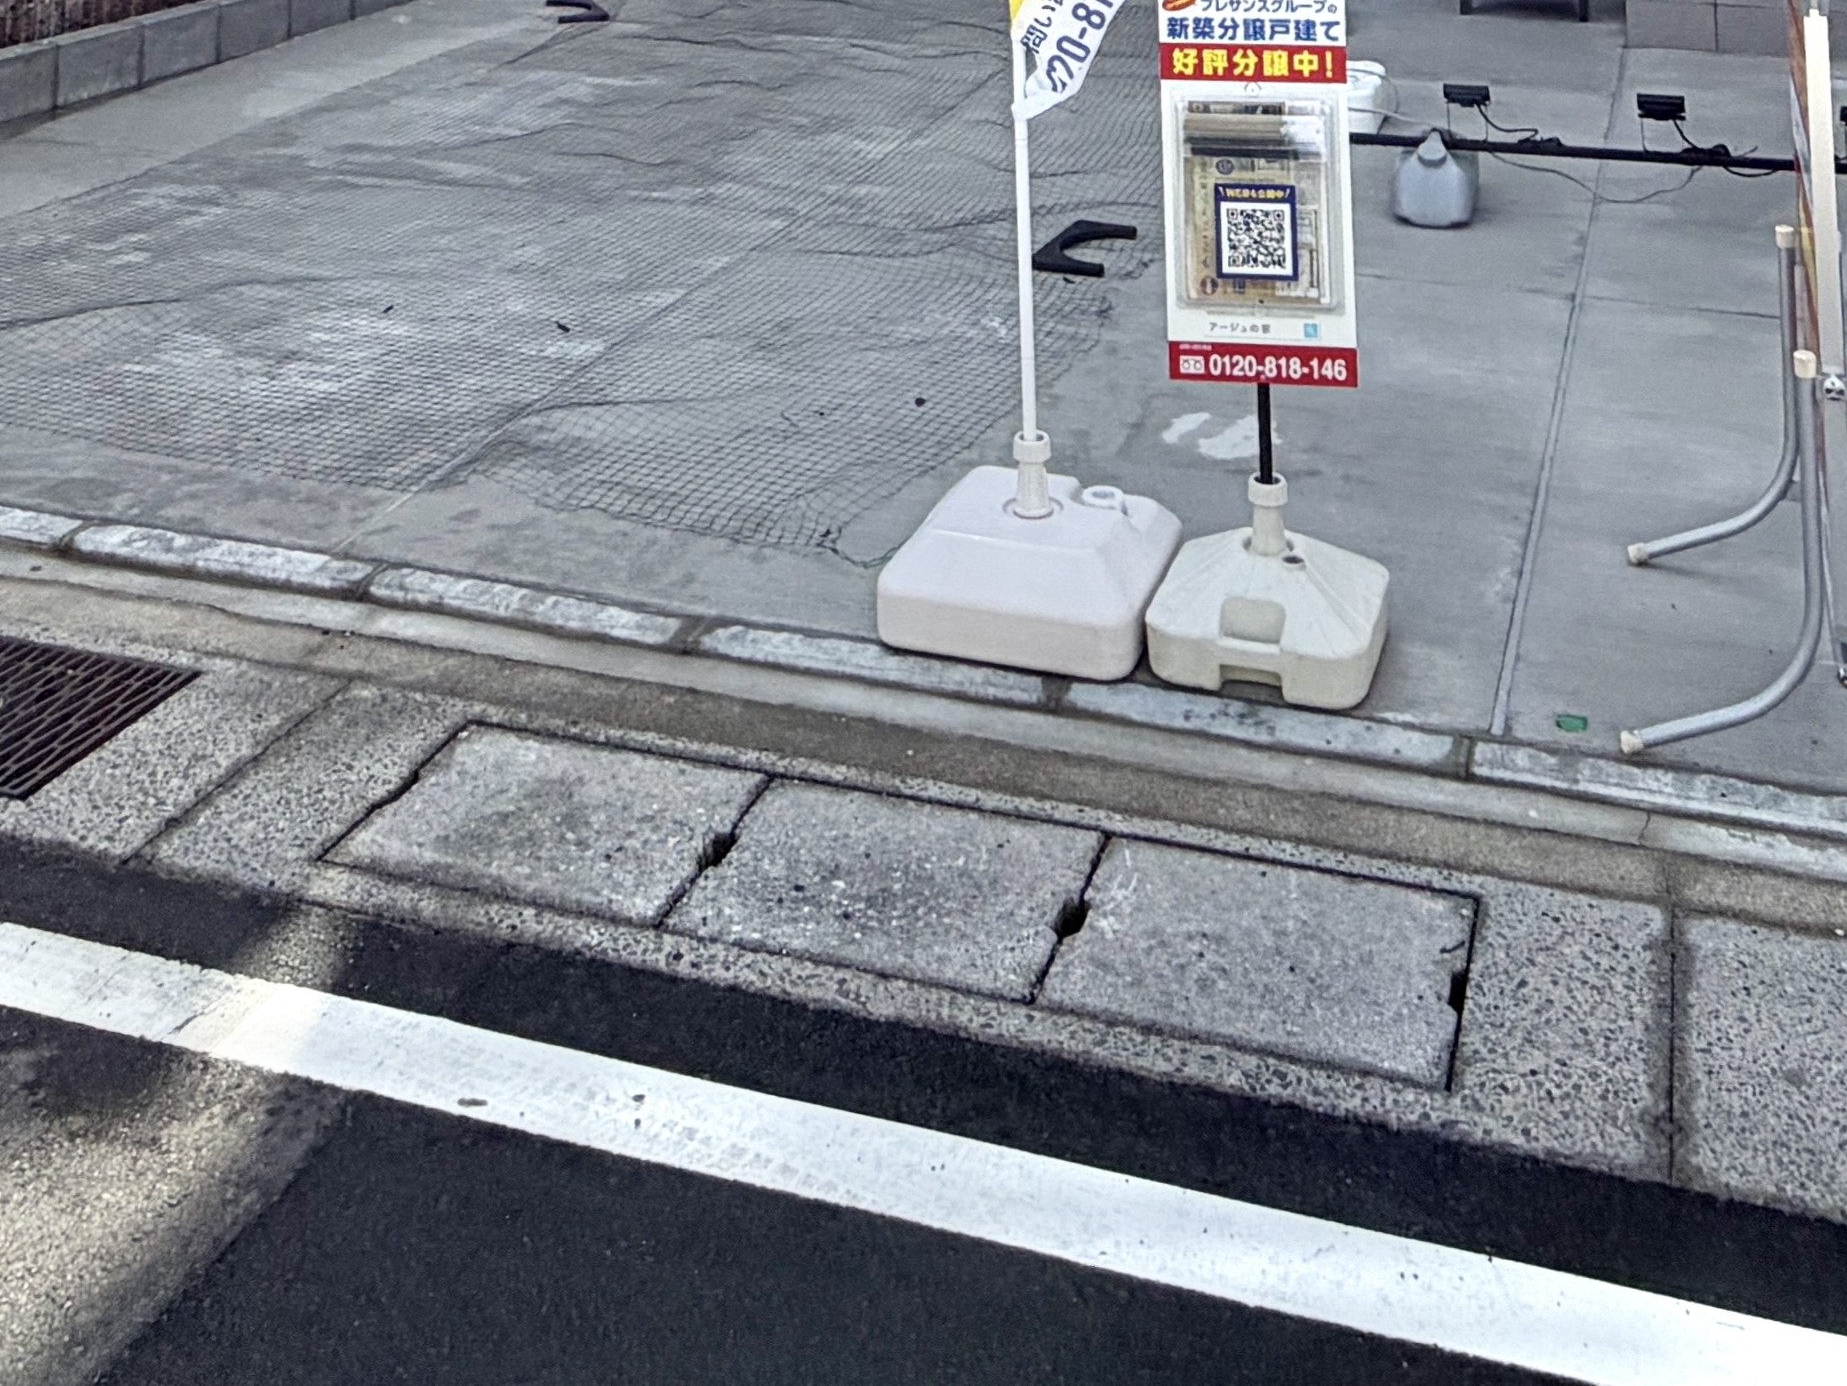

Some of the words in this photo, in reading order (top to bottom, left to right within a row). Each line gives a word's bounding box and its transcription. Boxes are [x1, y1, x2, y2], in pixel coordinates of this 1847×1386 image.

[1167, 17, 1340, 42] 新築分譲戸建て
[1172, 48, 1334, 78] 好評分譲中!
[1209, 354, 1348, 381] 0120-818-146
